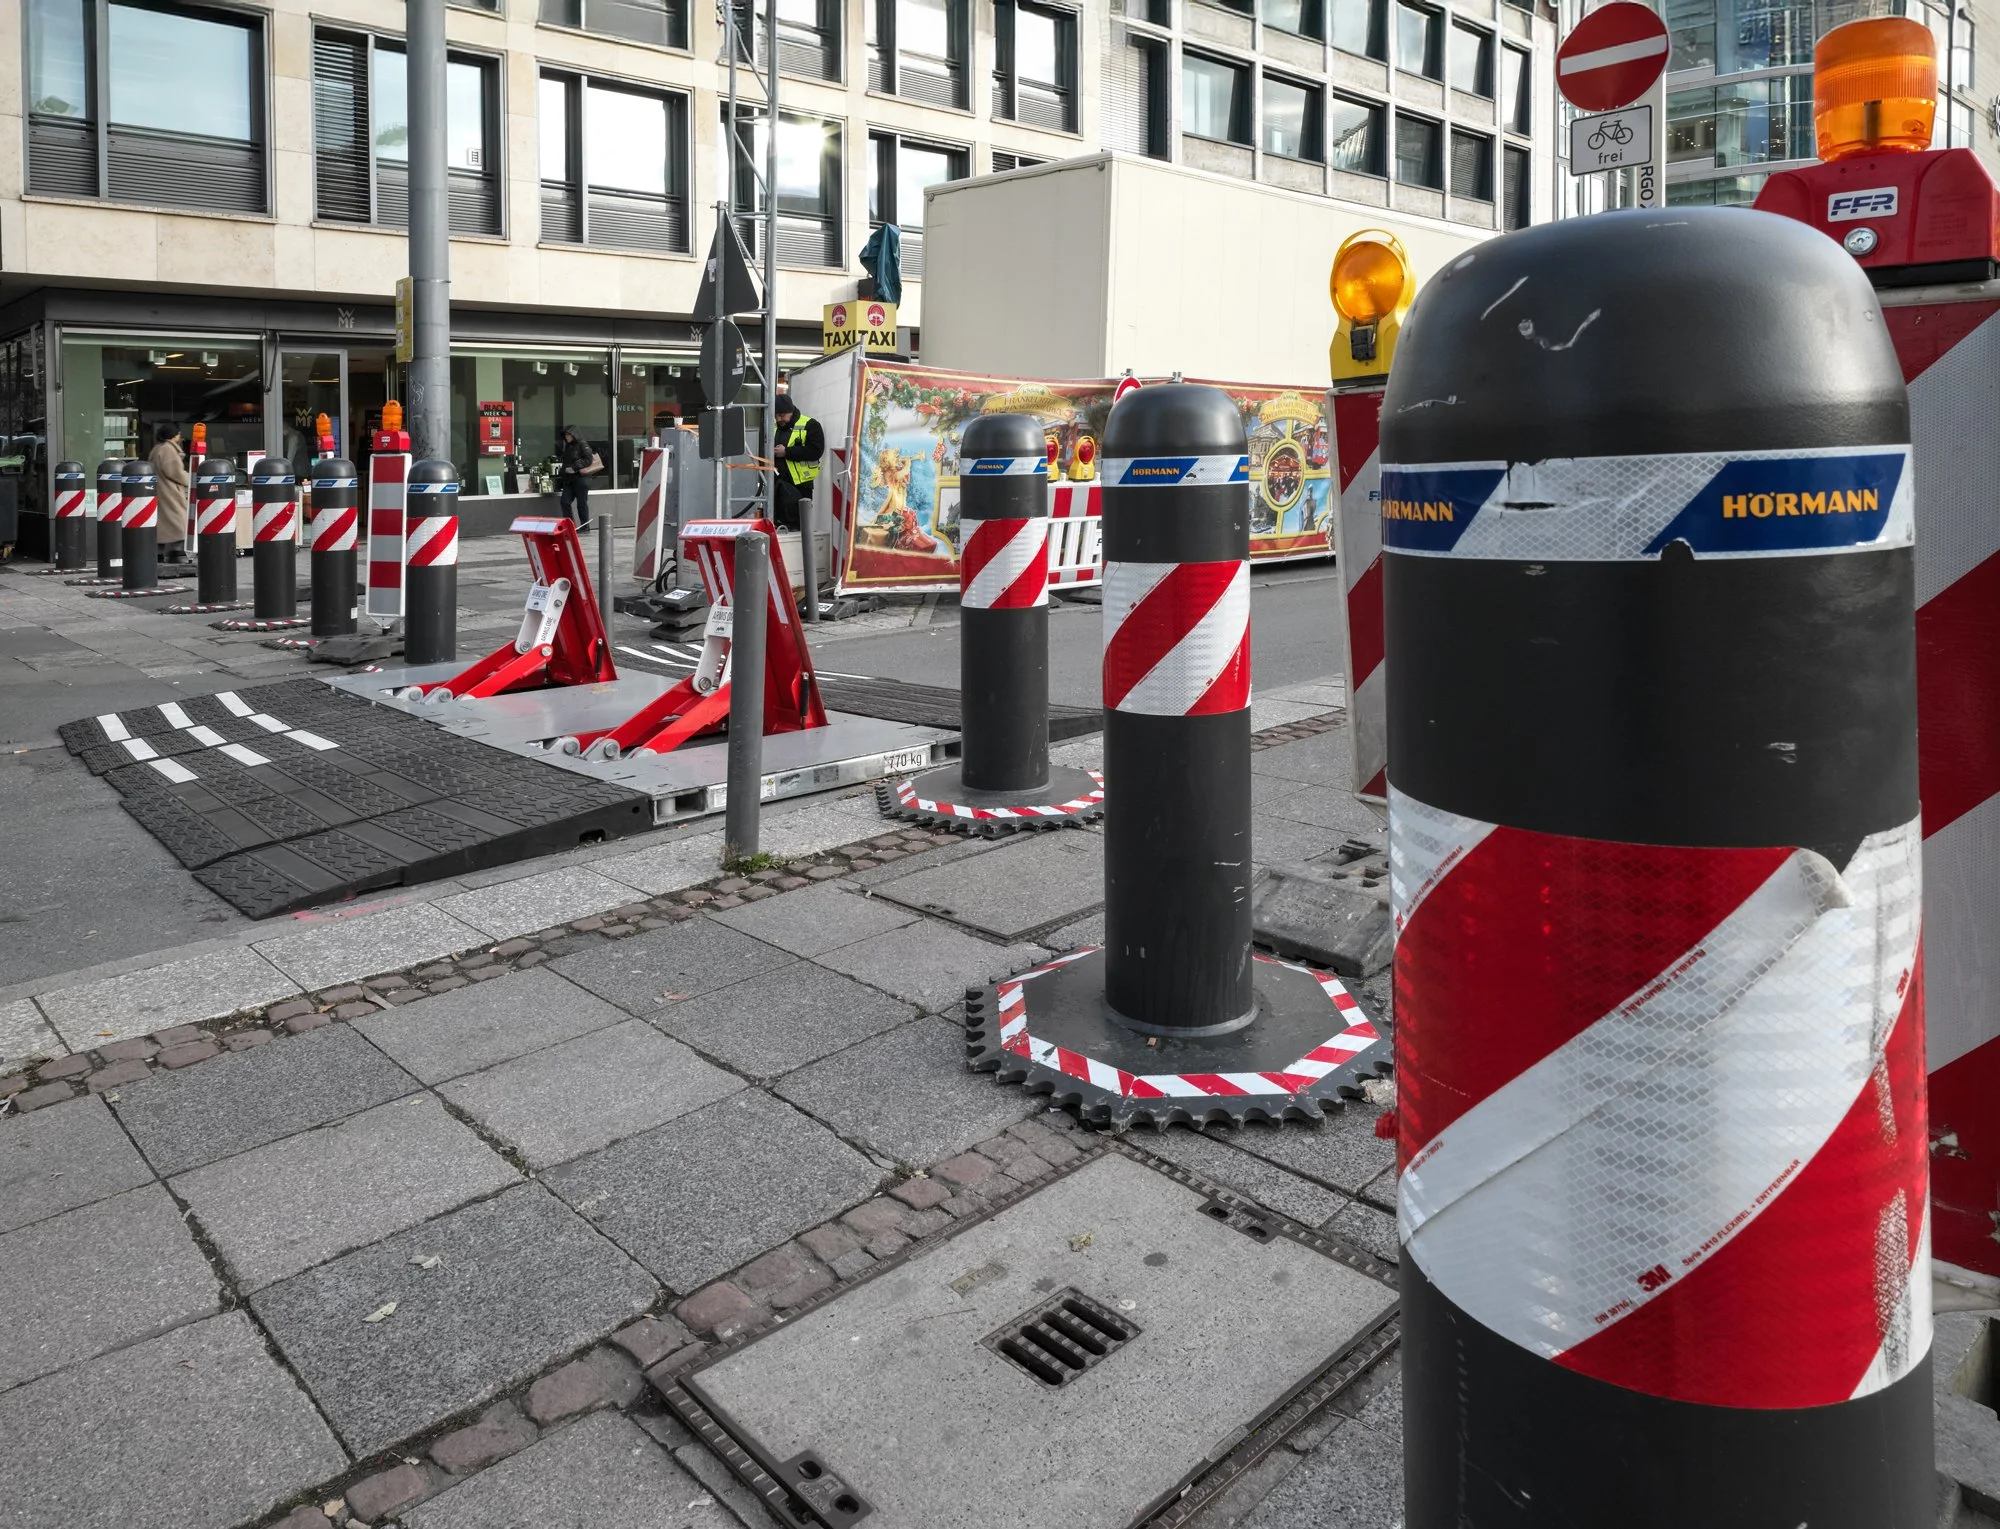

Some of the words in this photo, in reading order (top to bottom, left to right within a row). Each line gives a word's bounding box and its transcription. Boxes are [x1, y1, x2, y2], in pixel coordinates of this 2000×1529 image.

[1598, 148, 1623, 164] frei
[1831, 193, 1895, 216] FFR
[825, 330, 856, 348] TAXI
[858, 330, 896, 347] TAXI
[295, 407, 313, 428] WMF
[1722, 488, 1879, 519] HÖRMANN
[910, 752, 922, 766] kg
[1594, 1312, 1610, 1325] DIN
[1636, 1263, 1673, 1292] 3M
[1681, 1250, 1703, 1267] Serie
[1700, 1236, 1720, 1253] 3410
[1717, 1208, 1753, 1240] FLEXIBEL
[1754, 1158, 1802, 1205] ENTFERNBAR
